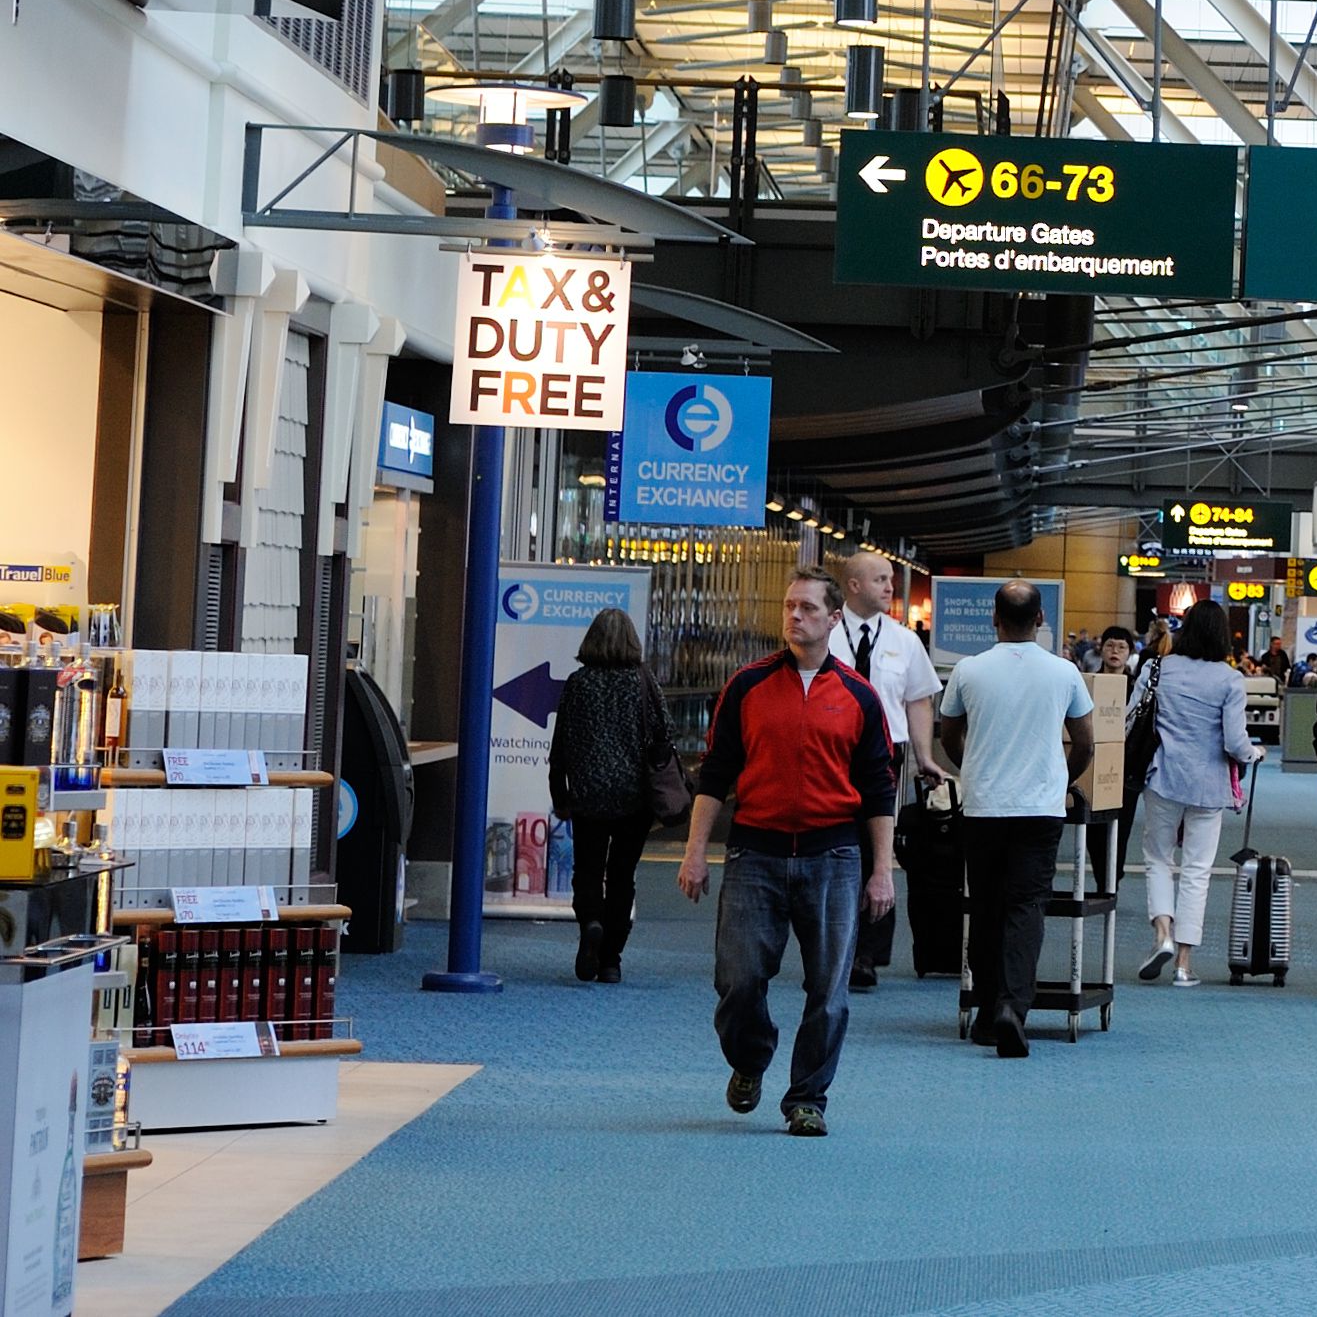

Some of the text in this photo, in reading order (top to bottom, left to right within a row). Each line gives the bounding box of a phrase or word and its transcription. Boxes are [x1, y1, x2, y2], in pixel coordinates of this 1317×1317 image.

[991, 161, 1116, 204] 66-73
[921, 218, 1094, 247] Departure Gates
[921, 246, 1174, 278] Portes d'embarquement
[468, 316, 616, 366] DUTY
[469, 369, 606, 419] FREE
[638, 460, 749, 484] CURRENCY
[636, 485, 749, 509] EXCHANGE
[0, 565, 71, 582] Travel Blue
[543, 589, 625, 605] CURRENCY
[494, 754, 540, 766] money
